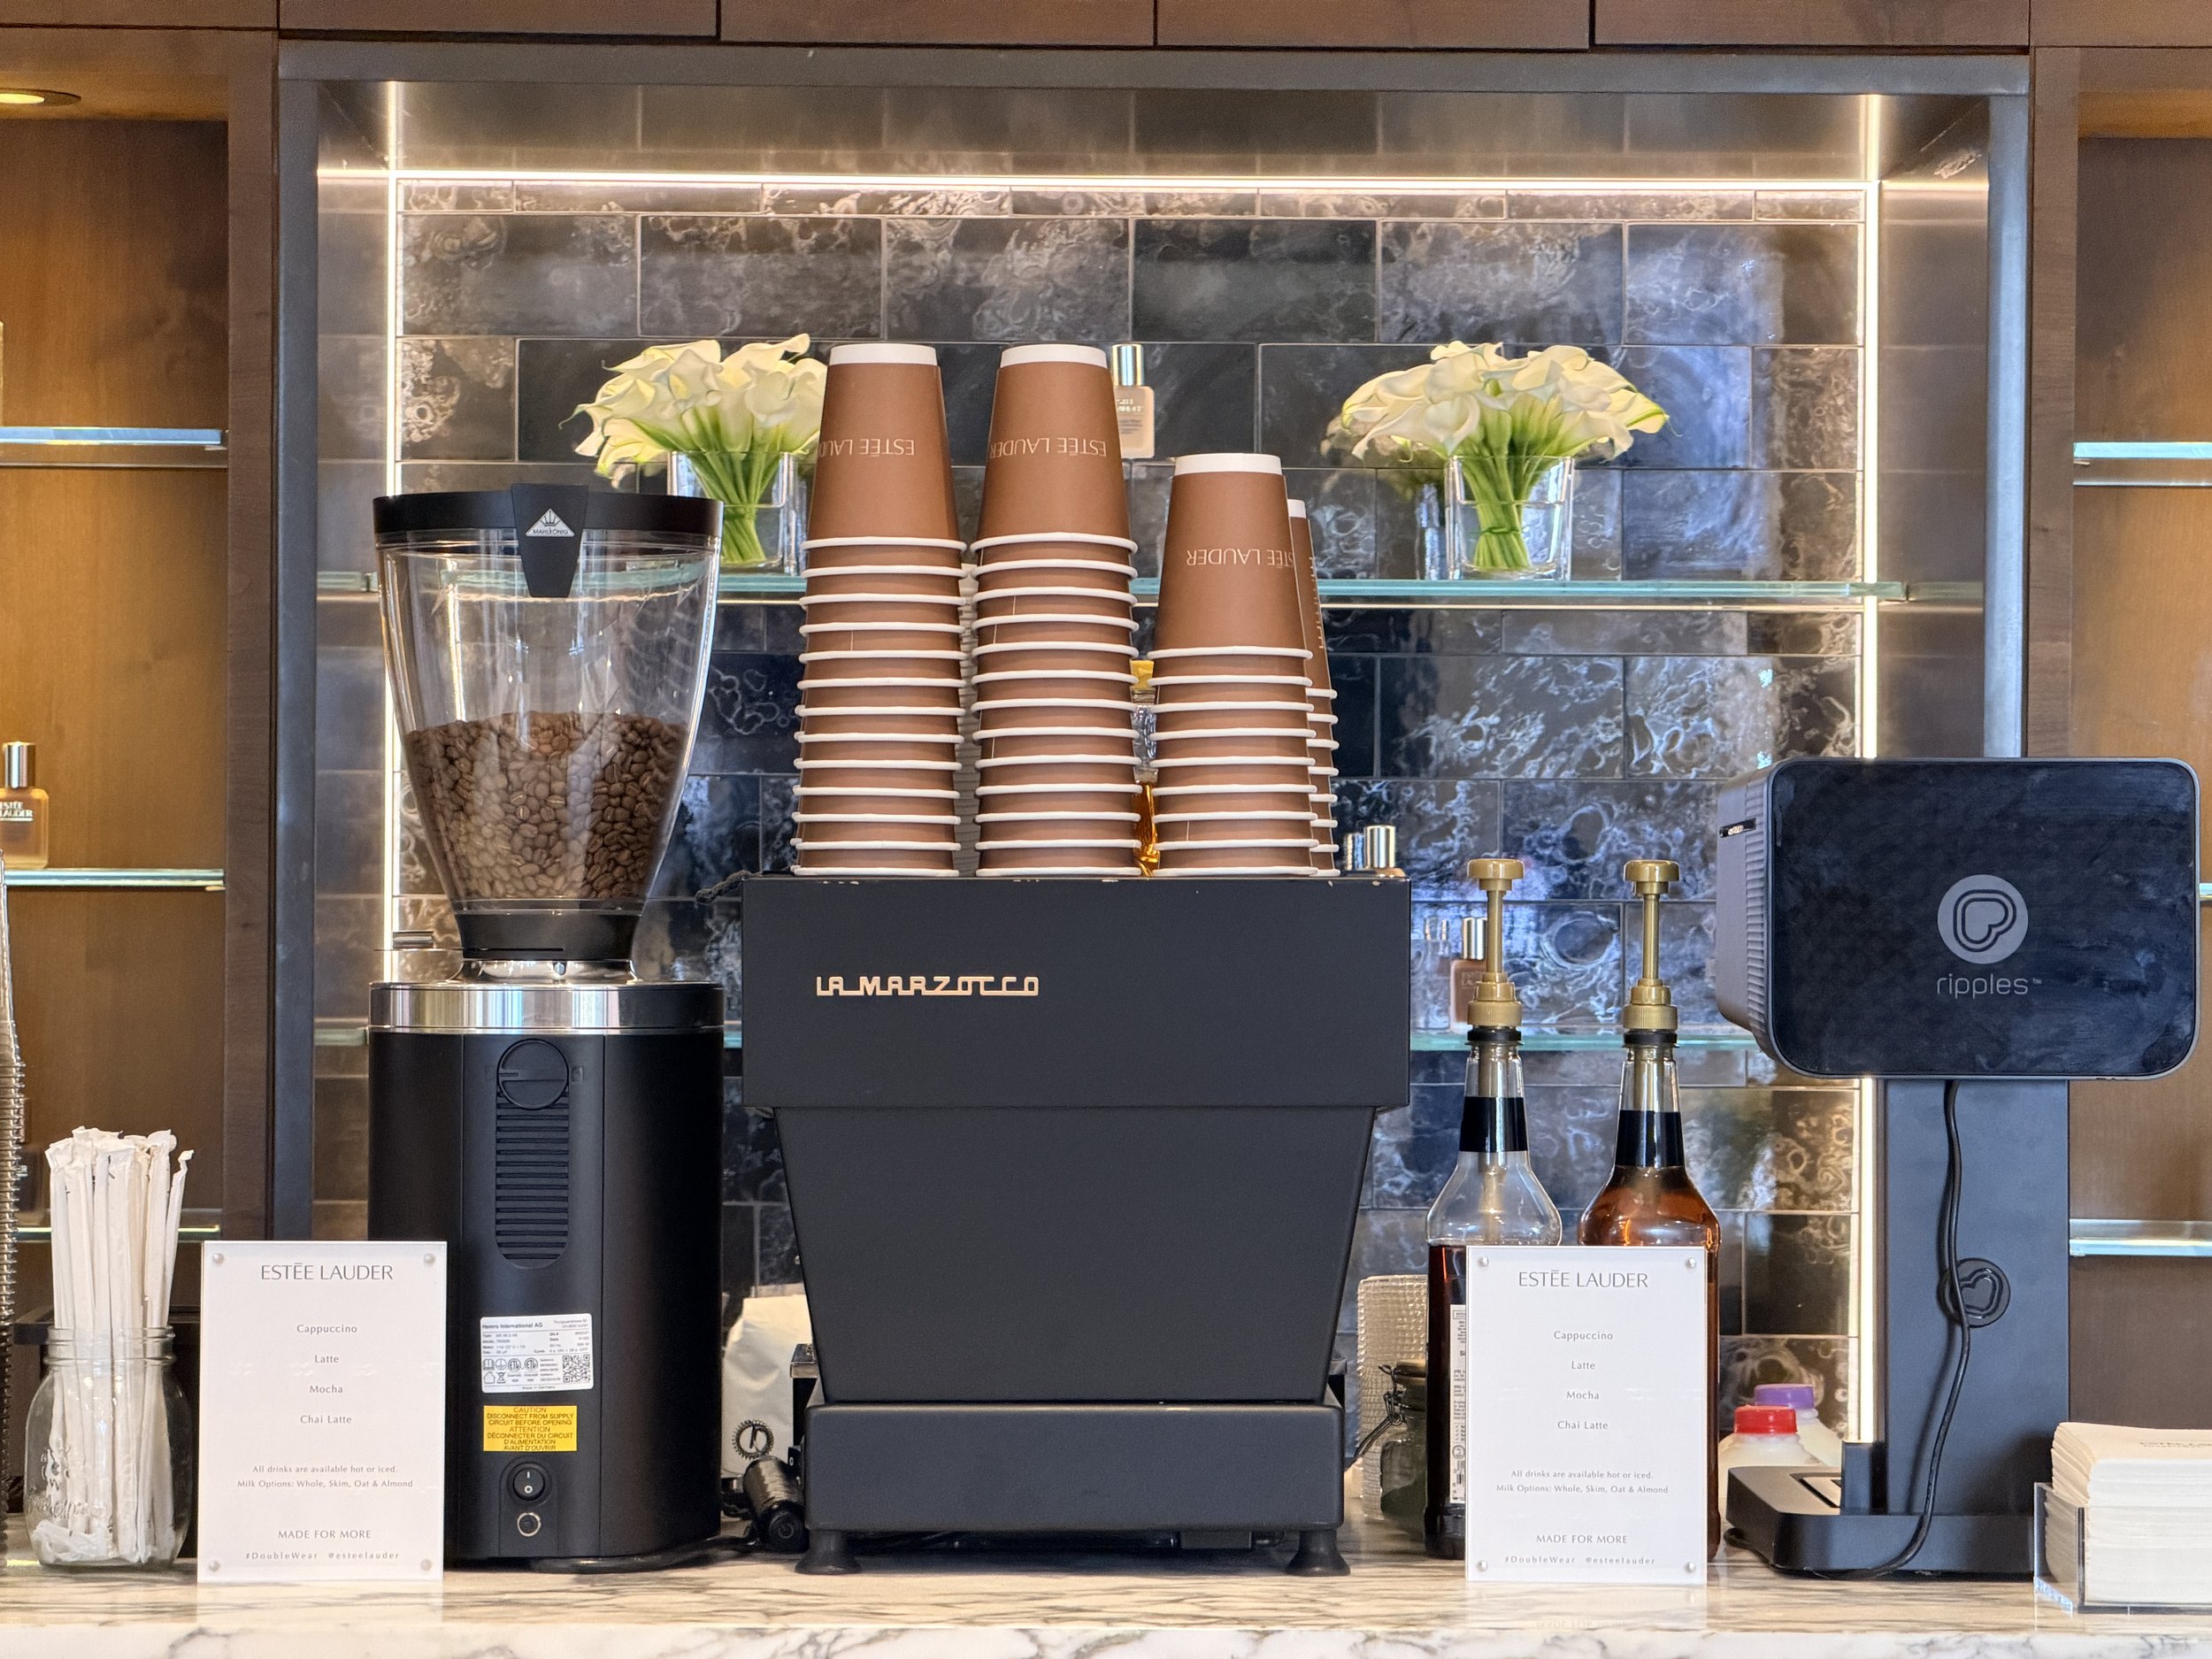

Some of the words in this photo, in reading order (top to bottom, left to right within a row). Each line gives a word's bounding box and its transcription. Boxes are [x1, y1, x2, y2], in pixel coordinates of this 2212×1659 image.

[989, 437, 1050, 459] LAUDER
[1186, 548, 1261, 566] LAUDER
[816, 976, 844, 996] LA
[1937, 972, 2029, 999] ripples
[319, 1264, 394, 1281] LAUDER
[1576, 1271, 1648, 1288] LAUDER
[296, 1324, 357, 1336] Cappuccino
[1553, 1330, 1614, 1342] Cappuccino
[314, 1354, 340, 1363] Latte
[1571, 1360, 1596, 1371] Latte
[309, 1384, 343, 1394] Mocha
[1566, 1390, 1600, 1400] Mocha
[300, 1414, 324, 1424] Chai
[327, 1415, 352, 1424] Latte
[1557, 1419, 1580, 1430] Chai
[1584, 1421, 1609, 1430] Latte
[252, 1464, 265, 1473] All
[311, 1464, 349, 1473] available
[349, 1464, 364, 1473] hot
[378, 1464, 398, 1473] iced.
[1525, 1469, 1550, 1478] drinks
[1568, 1470, 1605, 1479] available
[1607, 1470, 1620, 1479] hot
[1633, 1471, 1654, 1479] iced.
[257, 1479, 294, 1489] Options:
[296, 1479, 326, 1488] Whole,
[328, 1479, 351, 1488] Skim,
[1517, 1485, 1552, 1494] Options:
[1554, 1484, 1583, 1494] Whole,
[1586, 1485, 1608, 1494] Skim,
[1610, 1485, 1625, 1494] Oat
[278, 1530, 310, 1540] MADE
[314, 1529, 336, 1540] FOR
[339, 1529, 372, 1540] MORE
[1536, 1534, 1567, 1544] MADE
[1571, 1534, 1593, 1544] FOR
[1596, 1534, 1627, 1544] MORE
[245, 1551, 318, 1560] #DoubleWear
[1504, 1555, 1575, 1563] #DoubleWear
